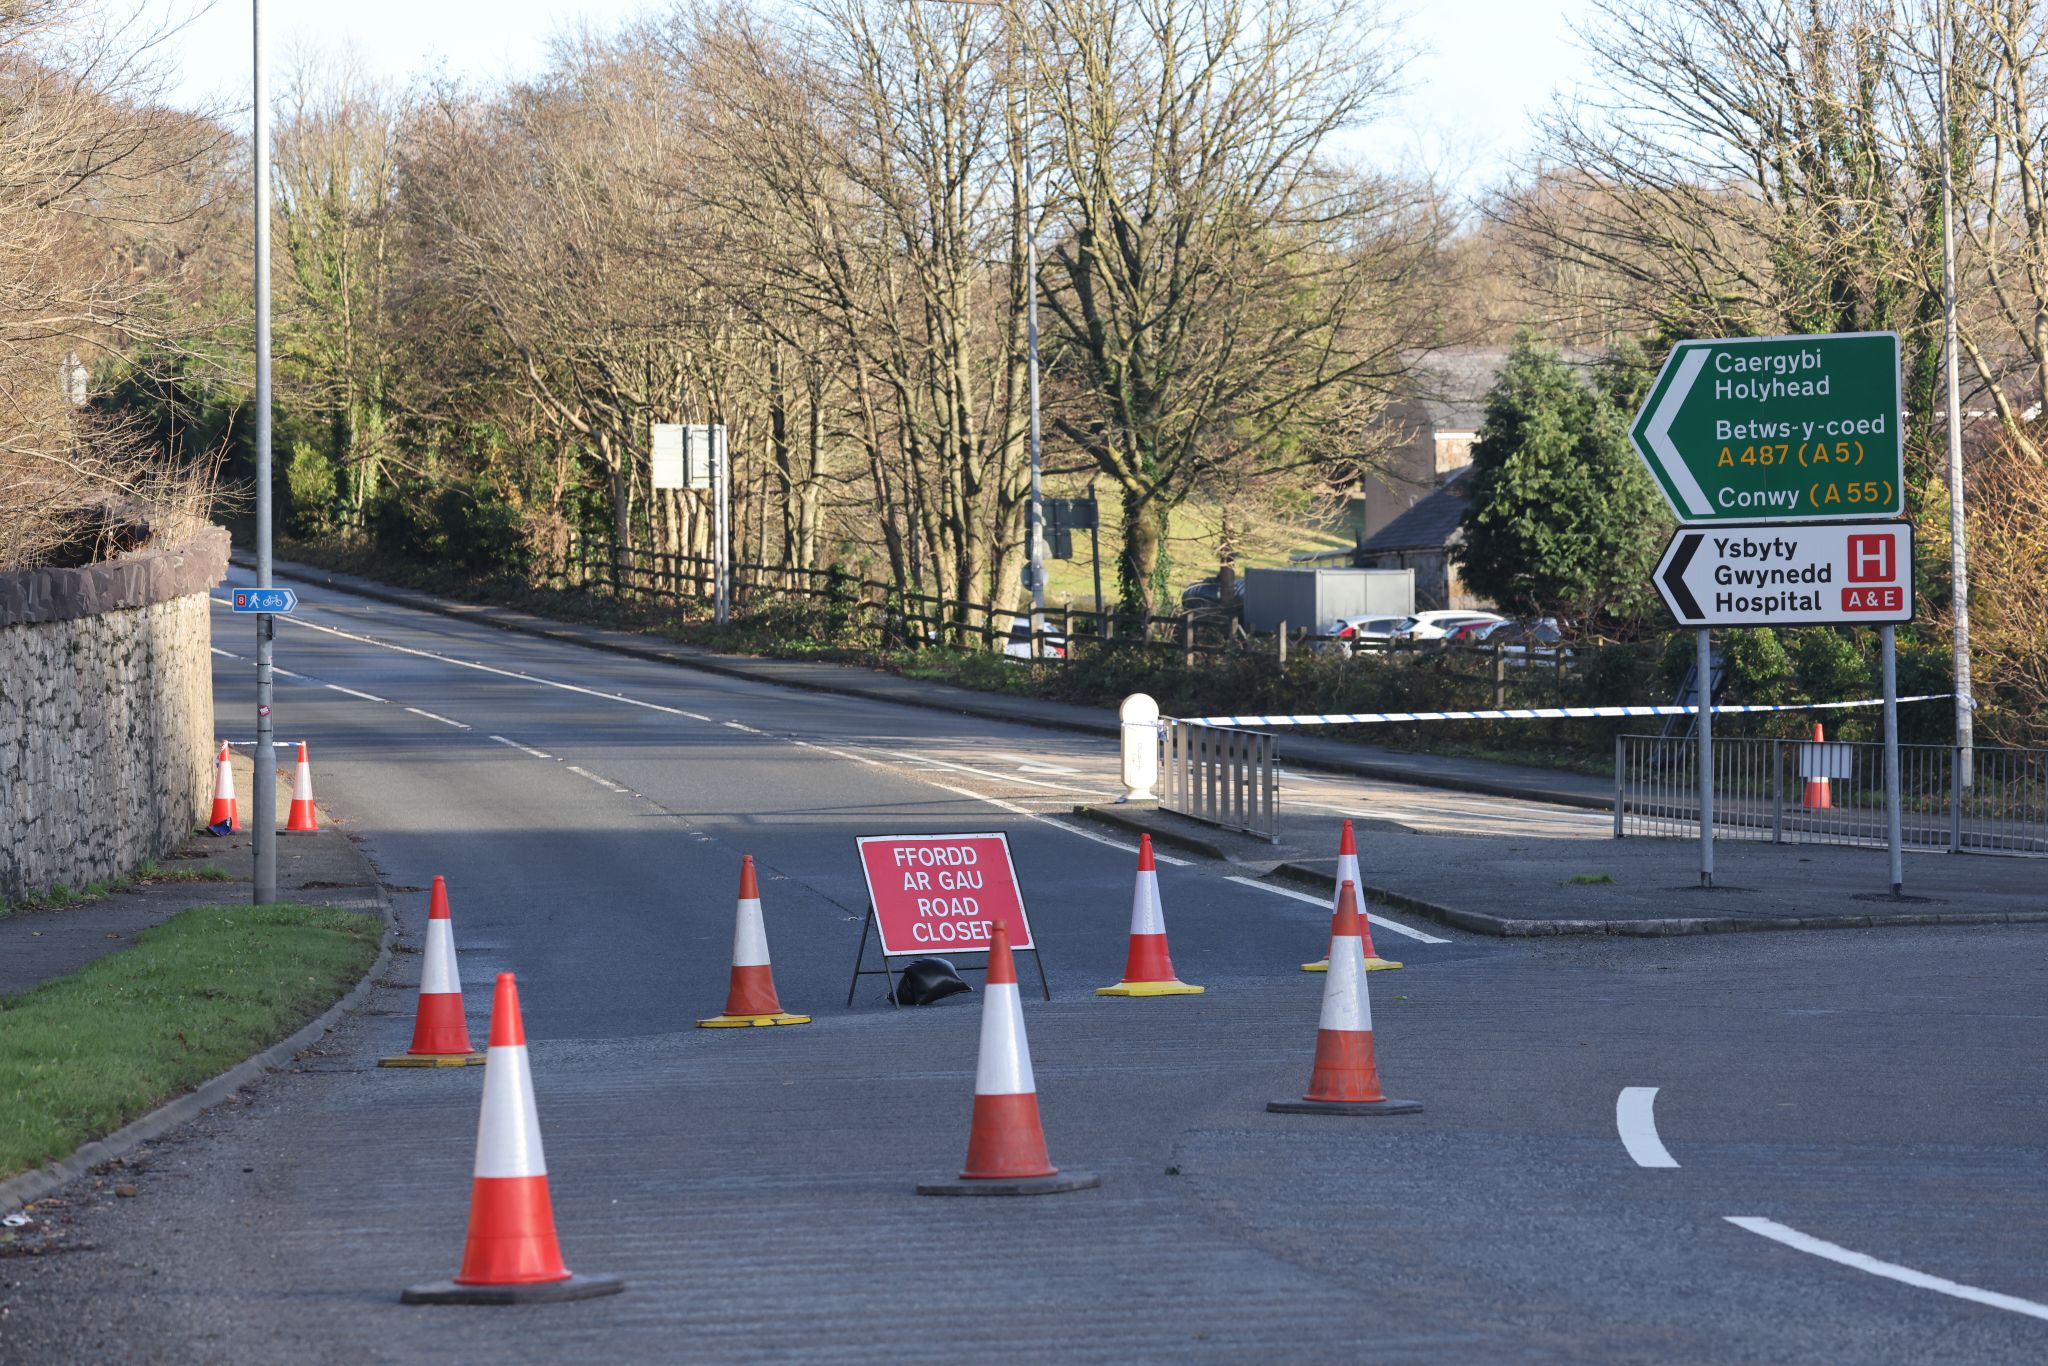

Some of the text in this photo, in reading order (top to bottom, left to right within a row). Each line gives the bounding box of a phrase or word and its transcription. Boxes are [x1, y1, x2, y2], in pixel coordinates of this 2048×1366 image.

[1715, 348, 1822, 375] Caergybi
[1715, 375, 1830, 402] Holyhead
[1716, 413, 1885, 441] Betws-y-coed
[1718, 486, 1800, 509] Conwy
[1713, 537, 1798, 562] Ysbyty
[1856, 539, 1887, 578] H
[1714, 562, 1832, 589] Gwynedd
[238, 596, 245, 605] 8
[1715, 590, 1822, 616] Hospital
[893, 846, 978, 867] FFORDD
[903, 870, 983, 891] AR GAU
[917, 897, 979, 917] ROAD
